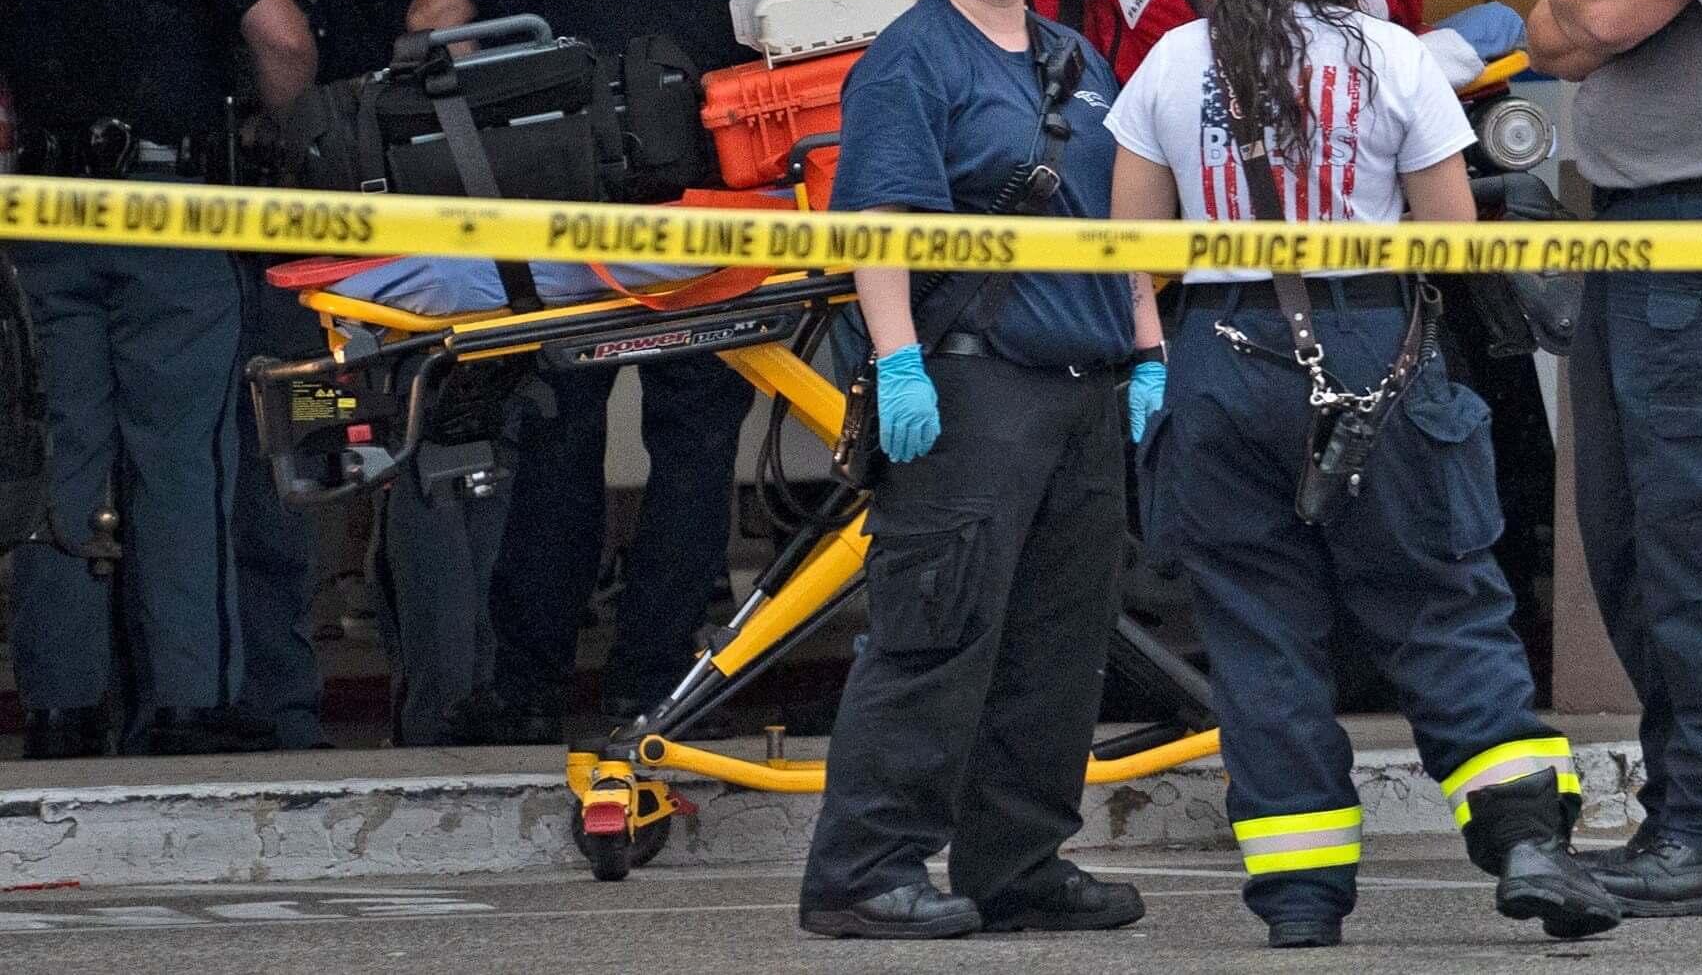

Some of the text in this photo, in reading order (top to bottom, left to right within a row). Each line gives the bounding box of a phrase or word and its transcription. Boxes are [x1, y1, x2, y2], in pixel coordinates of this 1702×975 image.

[36, 187, 110, 228] LINE
[123, 192, 169, 232] DO
[181, 196, 248, 236] NOT
[261, 200, 375, 243] CROSS
[547, 212, 1017, 264] POLICE LINE DO NOT CROSS
[1189, 232, 1653, 272] POLICE LINE DO NOT CROSS
[594, 330, 691, 360] power
